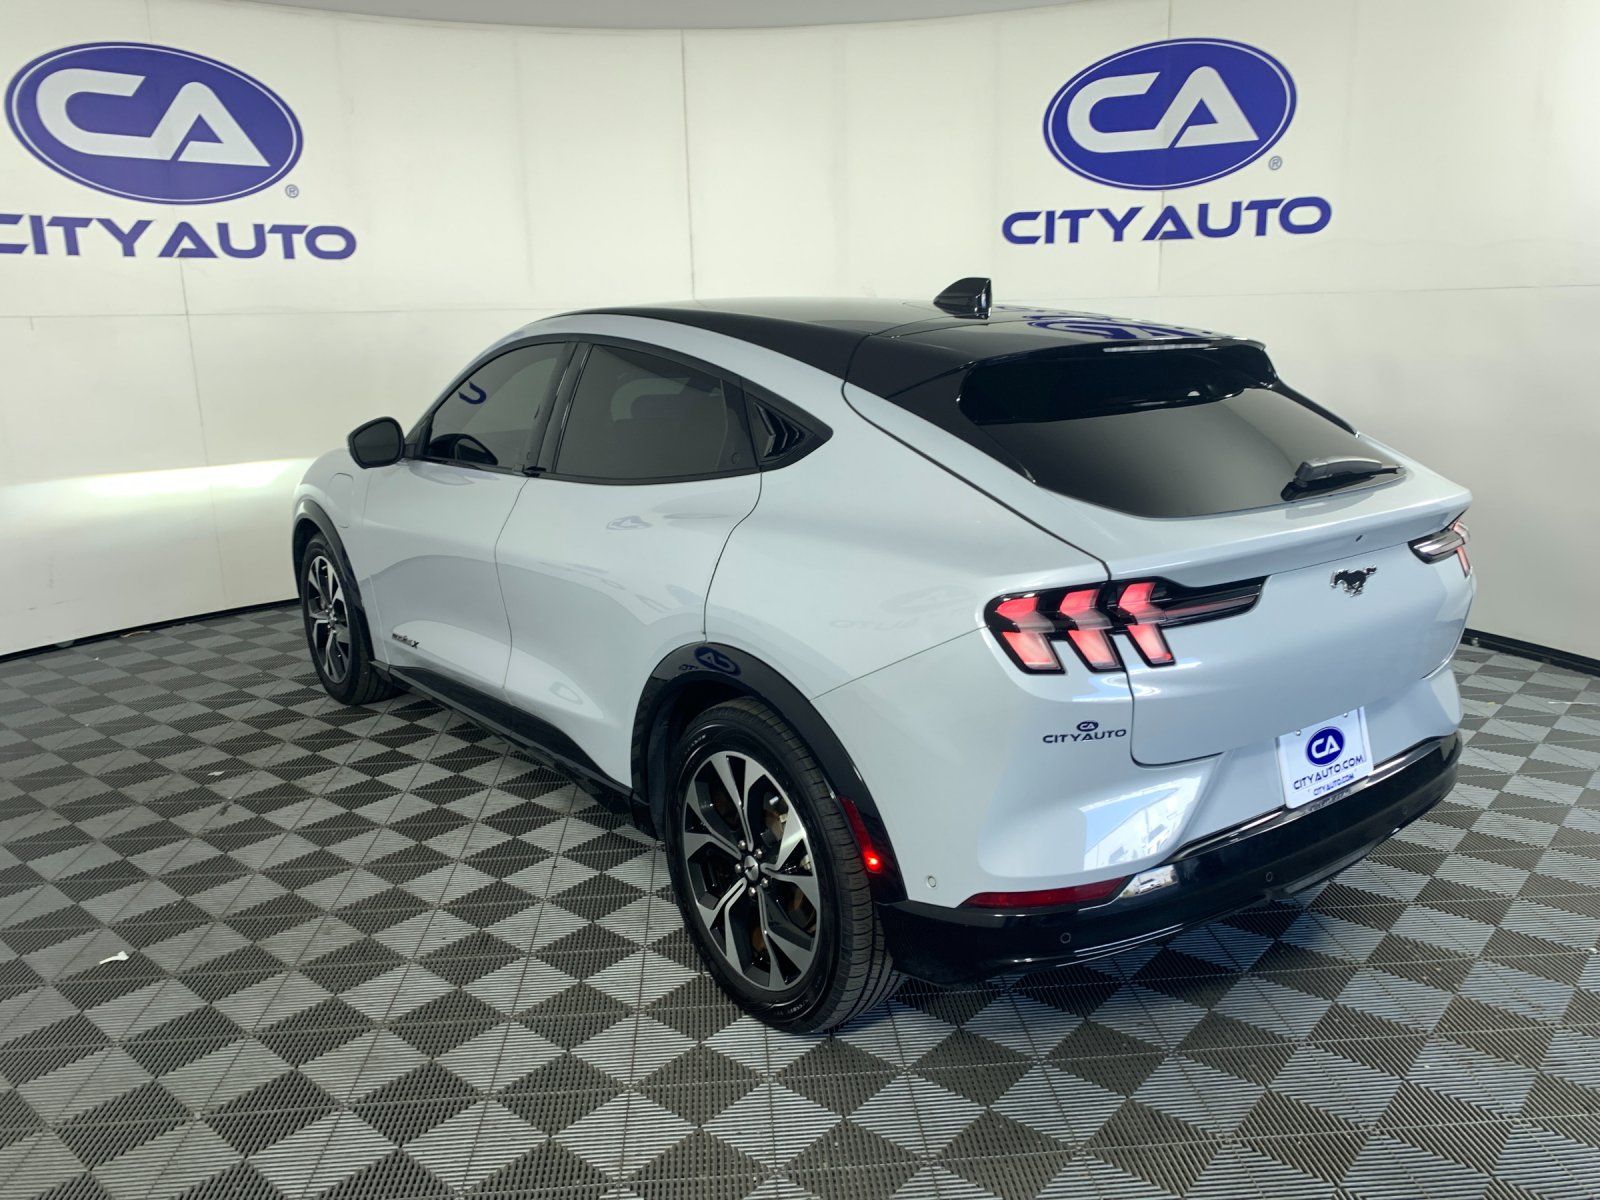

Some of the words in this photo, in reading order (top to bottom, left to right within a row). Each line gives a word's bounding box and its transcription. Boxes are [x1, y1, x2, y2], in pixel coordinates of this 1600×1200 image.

[36, 68, 271, 167] CA
[1067, 65, 1260, 153] CA
[1311, 734, 1340, 759] CA
